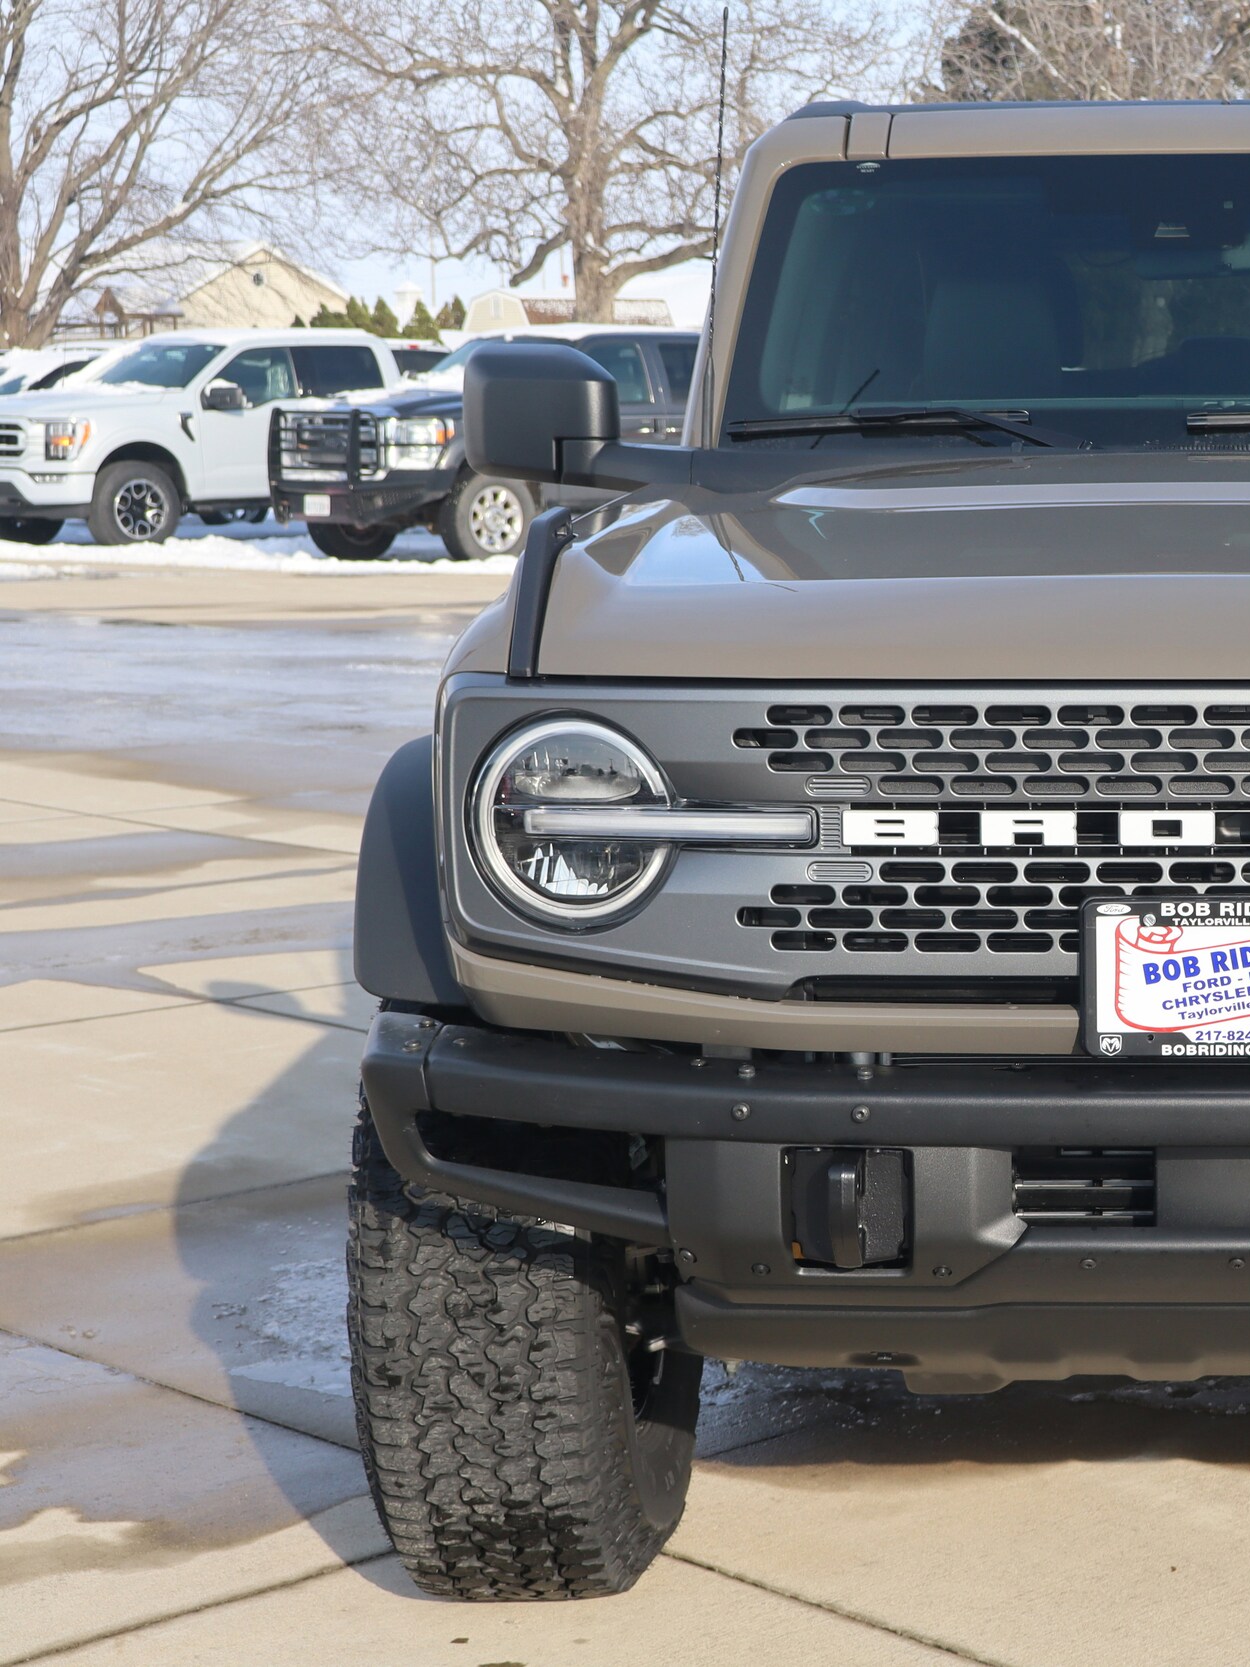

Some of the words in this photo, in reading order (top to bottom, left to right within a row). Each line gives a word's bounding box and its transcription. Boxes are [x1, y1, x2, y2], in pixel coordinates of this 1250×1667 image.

[1160, 902, 1211, 917] BOB
[1142, 955, 1201, 985] BOB
[1182, 975, 1232, 993] FORD
